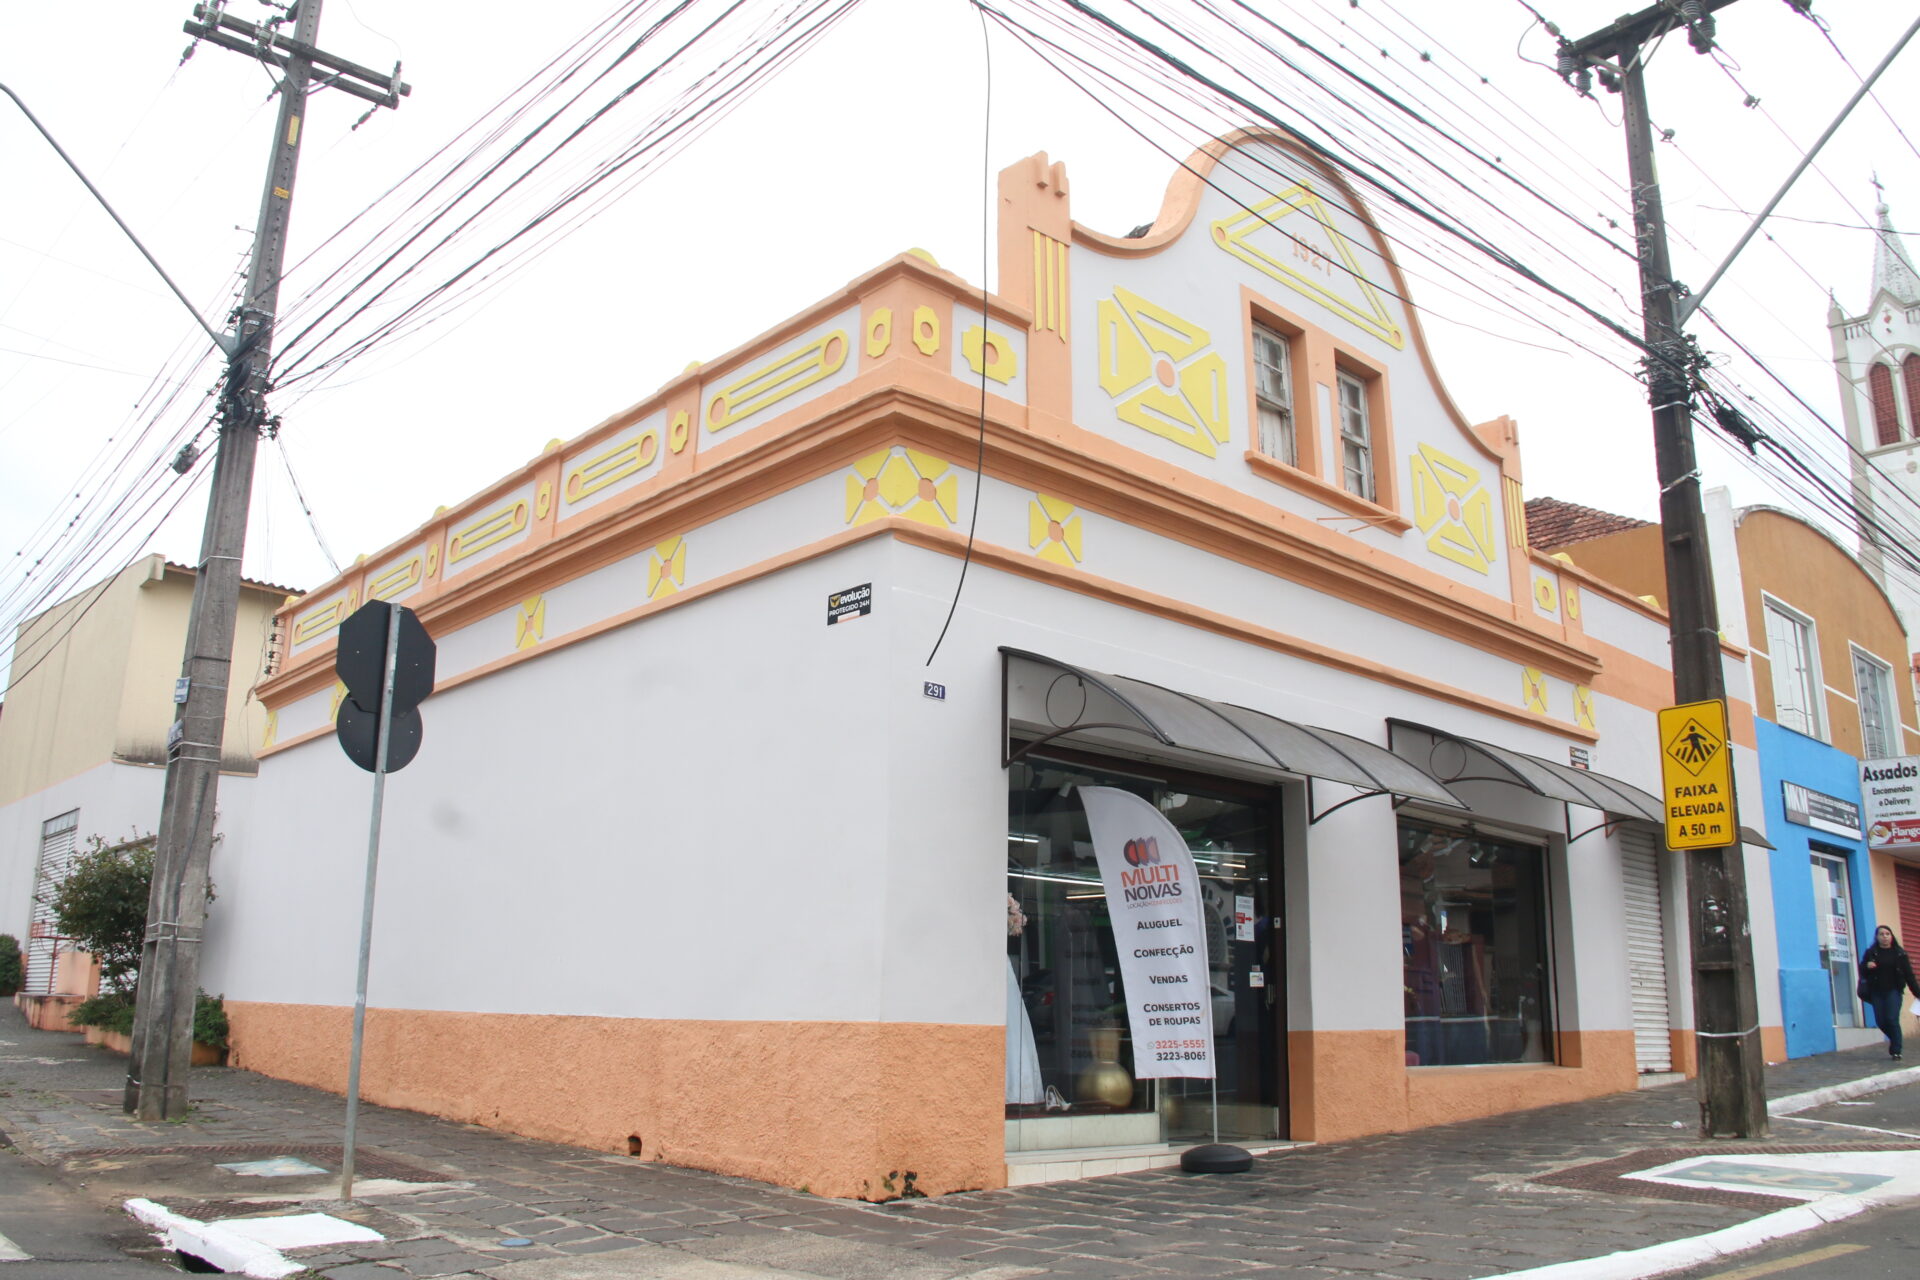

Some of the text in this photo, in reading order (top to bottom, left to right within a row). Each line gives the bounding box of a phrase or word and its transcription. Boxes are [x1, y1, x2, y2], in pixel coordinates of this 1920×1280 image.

[840, 587, 870, 604] evolução
[829, 603, 859, 616] PROTEGIDO
[928, 683, 943, 698] 291
[1863, 763, 1918, 782] Assados
[1675, 783, 1718, 798] FAIXA
[1872, 785, 1913, 795] Encomendas
[1671, 801, 1725, 817] ELEVADA
[1884, 797, 1910, 807] Delivery
[1679, 823, 1721, 837] A 50 m
[1121, 864, 1179, 888] MULTI
[1124, 882, 1182, 903] NOIVAS
[1137, 918, 1183, 930] ALUGUEL
[1133, 944, 1194, 958] CONFECÇÃO
[1149, 975, 1188, 984] VENDAS
[1143, 1002, 1201, 1013] CONSERTOS
[1149, 1016, 1201, 1026] DE ROUPAS
